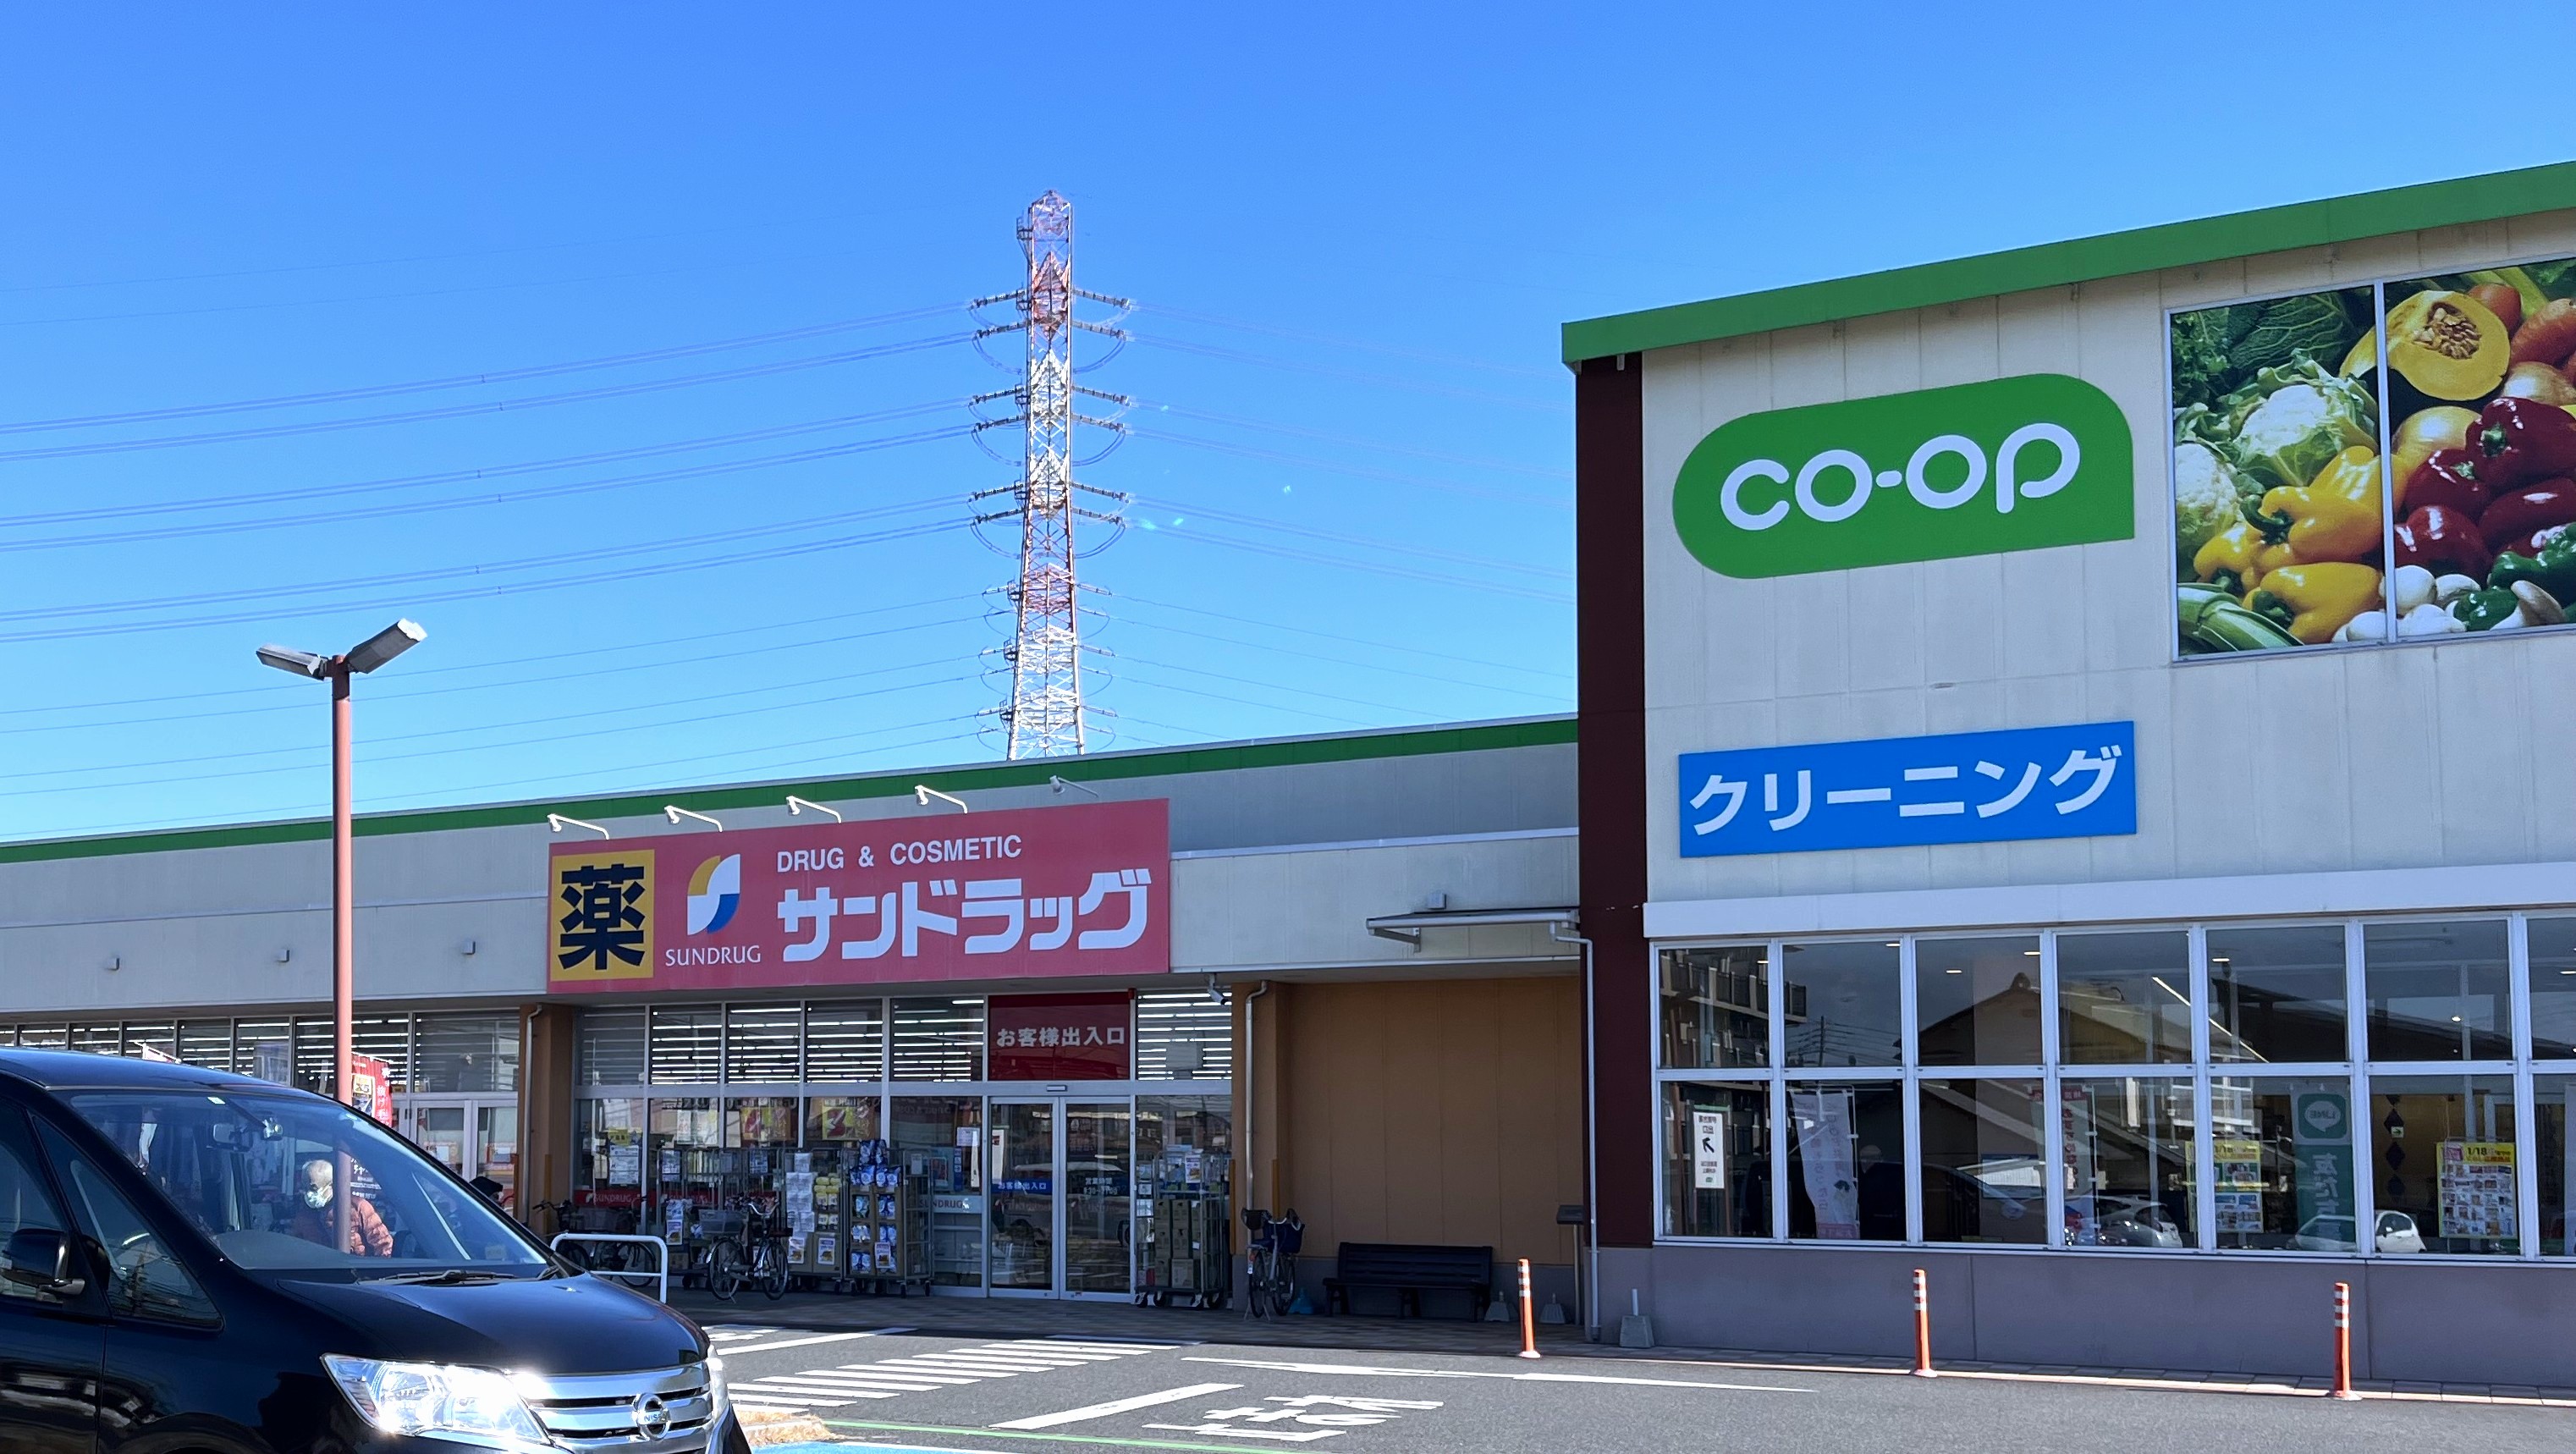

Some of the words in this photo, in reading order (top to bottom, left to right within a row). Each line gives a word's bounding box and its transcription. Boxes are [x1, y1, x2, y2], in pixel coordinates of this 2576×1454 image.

[1689, 744, 2122, 836] クリーニング
[777, 846, 845, 873] DRUG
[857, 845, 875, 867] &
[889, 834, 1022, 866] COSMETIC
[558, 863, 647, 971] 薬
[777, 868, 1152, 962] サンドラッグ
[664, 945, 762, 967] SUNDRUG
[996, 1026, 1126, 1048] お客様出入口
